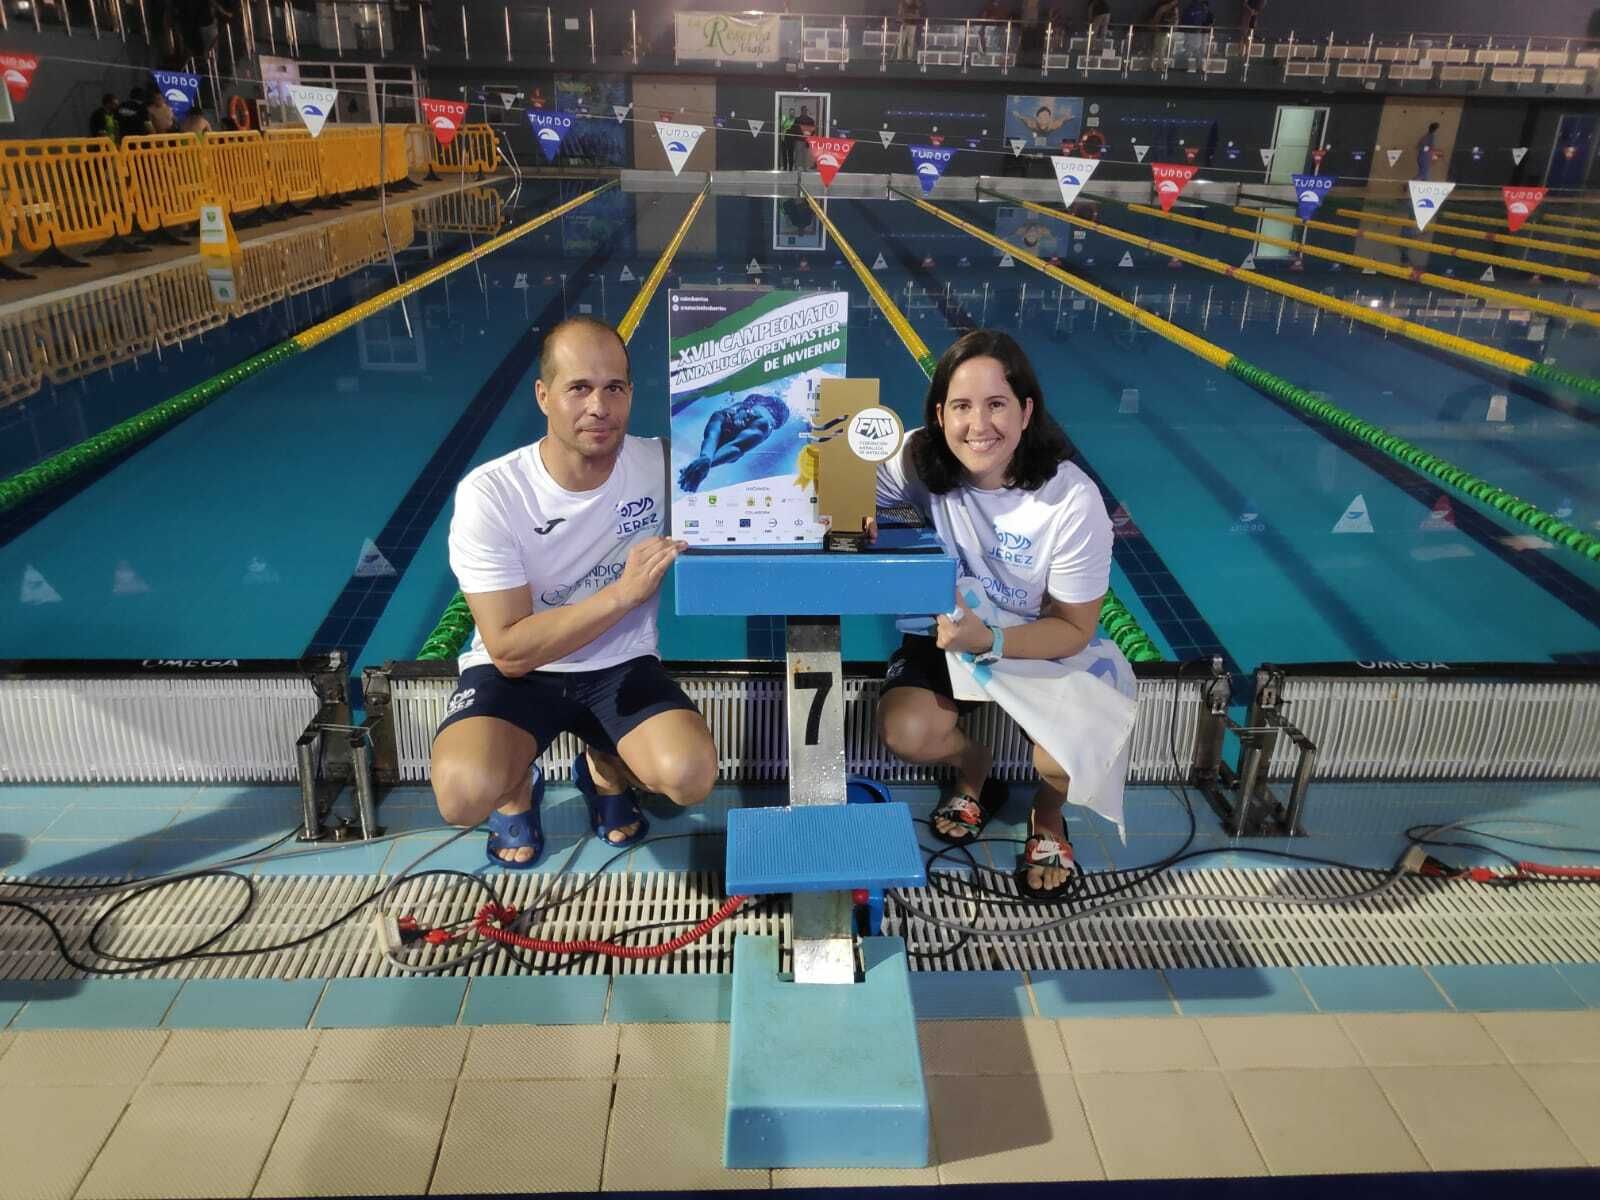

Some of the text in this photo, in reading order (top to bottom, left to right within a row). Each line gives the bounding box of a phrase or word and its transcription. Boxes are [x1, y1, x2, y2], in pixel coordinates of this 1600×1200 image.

[155, 74, 198, 88] TURBO
[422, 103, 465, 114] TURBO
[528, 113, 571, 127] TURBO
[658, 127, 700, 139] TURBO
[809, 141, 850, 153] TURBO
[911, 150, 951, 161] TURBO
[1153, 167, 1192, 179] TURBO
[1294, 178, 1332, 189] TURBO
[1504, 190, 1543, 200] TURBO
[677, 300, 839, 368] XVII CAMPEONATO
[675, 321, 840, 386] ANDALUCÍA OPEN MASTER
[764, 338, 841, 372] DE INVIERNO
[855, 417, 894, 440] FAN
[616, 513, 659, 535] JEREZ
[989, 546, 1034, 566] JEREZ
[1356, 659, 1451, 670] OMEGA
[794, 672, 833, 746] 7
